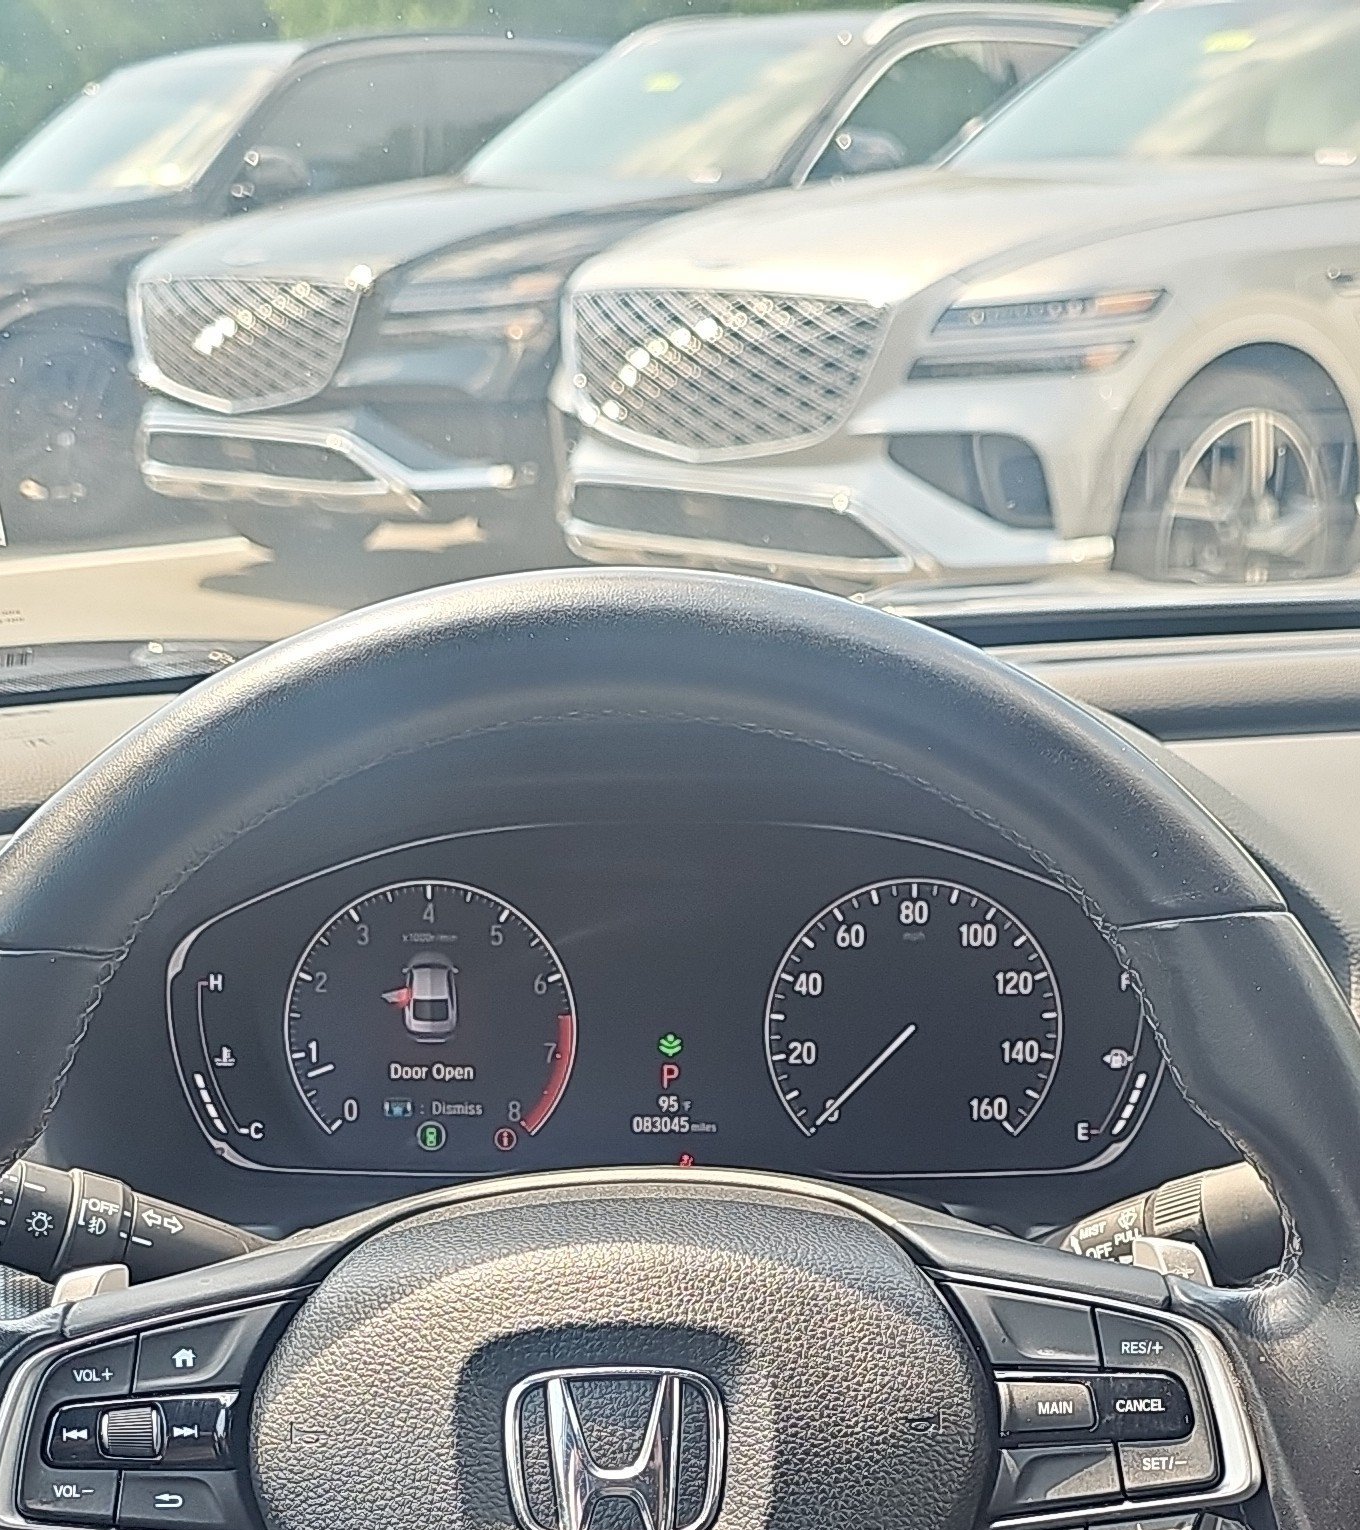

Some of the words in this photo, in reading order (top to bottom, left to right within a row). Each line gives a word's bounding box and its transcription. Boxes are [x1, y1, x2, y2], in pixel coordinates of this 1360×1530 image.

[422, 903, 436, 924] 4
[899, 901, 929, 924] 80
[356, 925, 370, 945] 3
[490, 925, 504, 946] 5
[836, 924, 865, 948] 60
[959, 924, 997, 948] 100
[208, 974, 224, 991] H
[315, 972, 328, 993] 2
[534, 973, 547, 994] 6
[794, 972, 823, 996] 40
[995, 972, 1034, 995] 120
[307, 1041, 320, 1063] 1
[544, 1043, 557, 1063] 7
[787, 1042, 817, 1065] 20
[1001, 1041, 1040, 1064] 140
[390, 1063, 428, 1079] Door
[432, 1063, 474, 1082] Open
[662, 1064, 680, 1089] P
[343, 1100, 358, 1122] 0
[432, 1101, 483, 1116] Dismiss
[508, 1101, 522, 1122] 8
[658, 1095, 679, 1113] 95
[970, 1099, 1007, 1121] 160
[250, 1122, 264, 1139] C
[632, 1116, 690, 1133] 083045
[1077, 1123, 1090, 1140] E
[88, 1198, 120, 1216] OFF
[1079, 1221, 1107, 1240] MIST
[1114, 1227, 1142, 1245] PULL
[1085, 1241, 1113, 1259] OFF
[1121, 1341, 1164, 1356] RES/+
[73, 1368, 114, 1383] VOL+
[1038, 1401, 1073, 1416] MAIN
[1115, 1398, 1166, 1414] CANCEL
